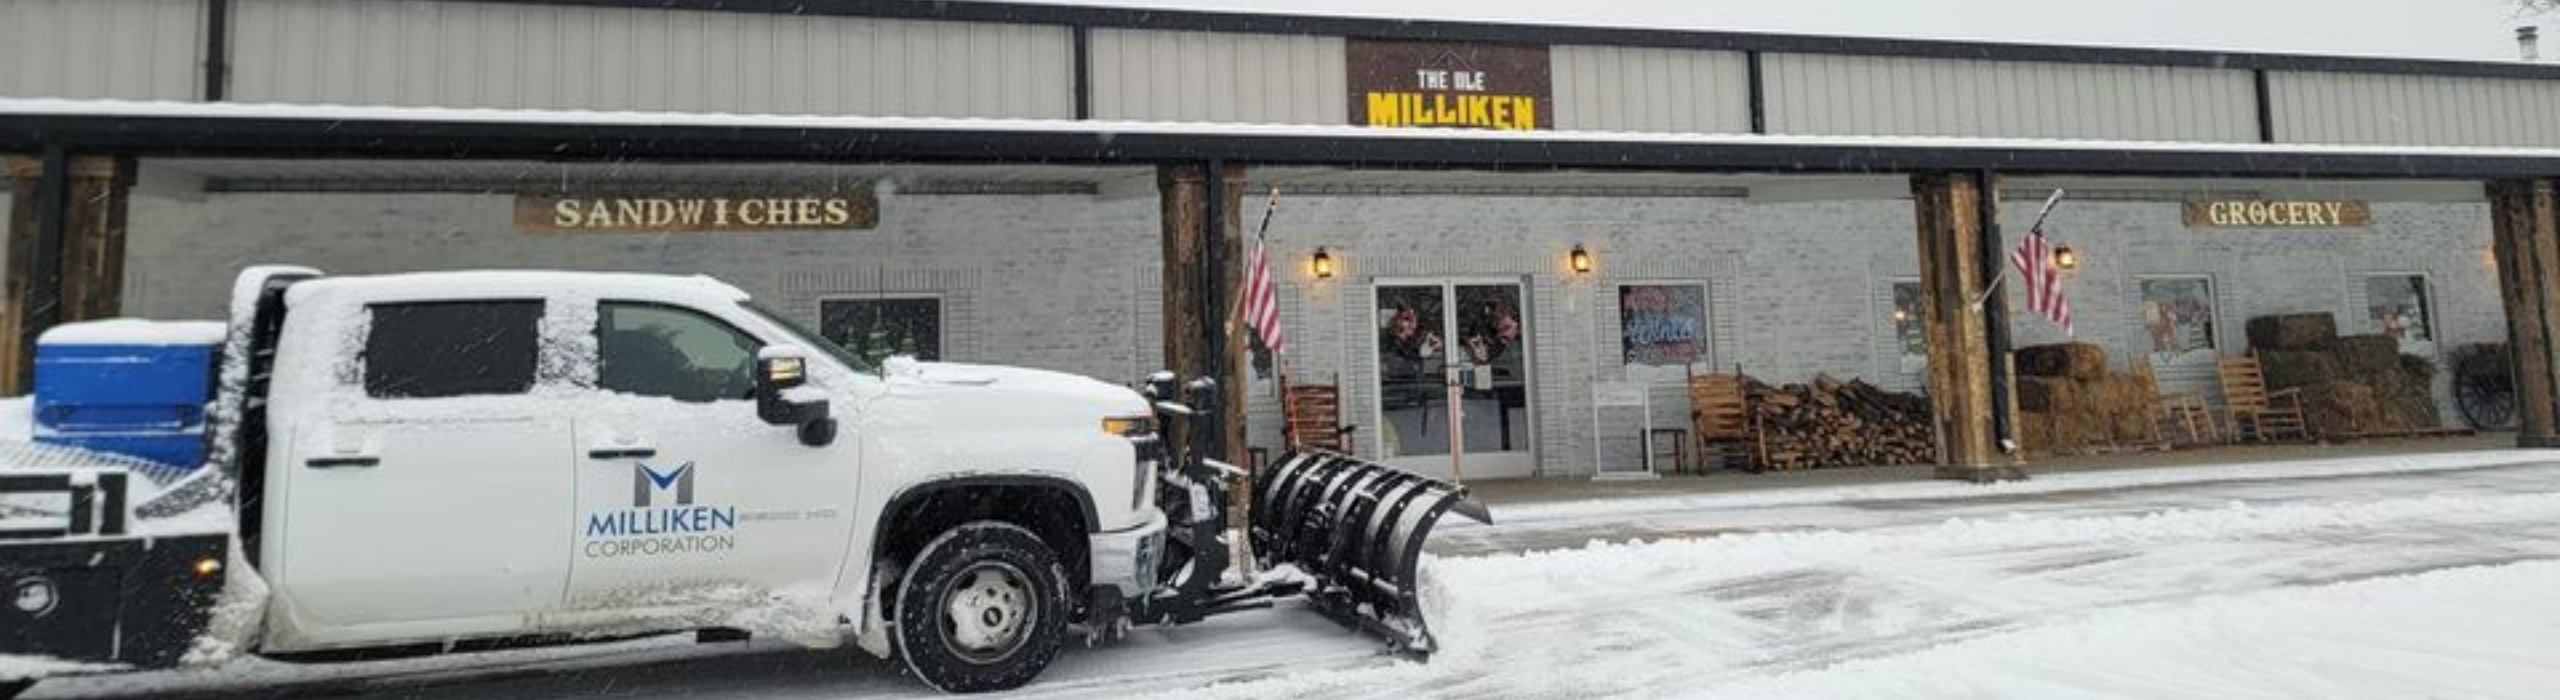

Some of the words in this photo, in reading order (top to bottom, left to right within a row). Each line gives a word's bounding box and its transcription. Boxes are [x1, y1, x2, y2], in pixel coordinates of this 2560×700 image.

[1416, 68, 1449, 90] THE
[1366, 91, 1536, 131] MILLIKEN
[555, 198, 849, 227] SANDWICHES
[2210, 201, 2342, 225] GROCERY
[587, 506, 735, 537] MILLIKEN
[585, 534, 735, 559] CORPORATION
